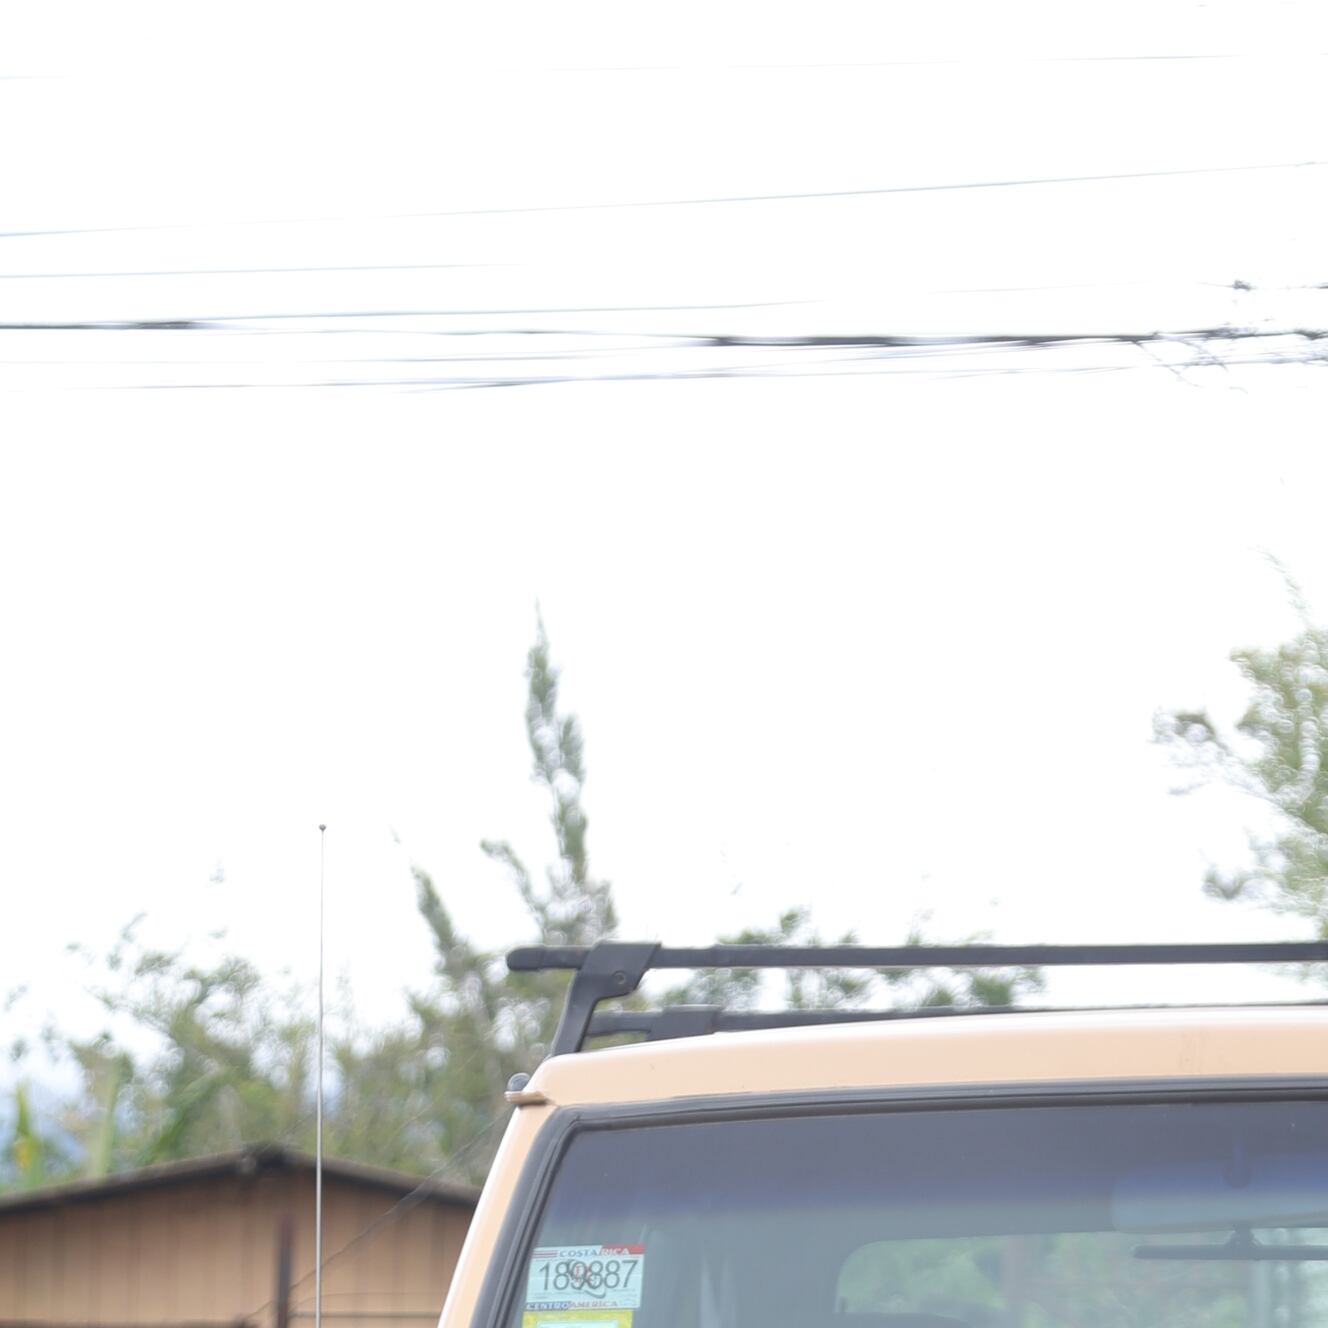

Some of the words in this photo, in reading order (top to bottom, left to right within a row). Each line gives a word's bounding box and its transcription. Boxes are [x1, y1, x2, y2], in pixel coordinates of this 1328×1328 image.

[559, 1248, 599, 1258] COSTA
[600, 1247, 630, 1256] RICA
[539, 1259, 639, 1291] 189887
